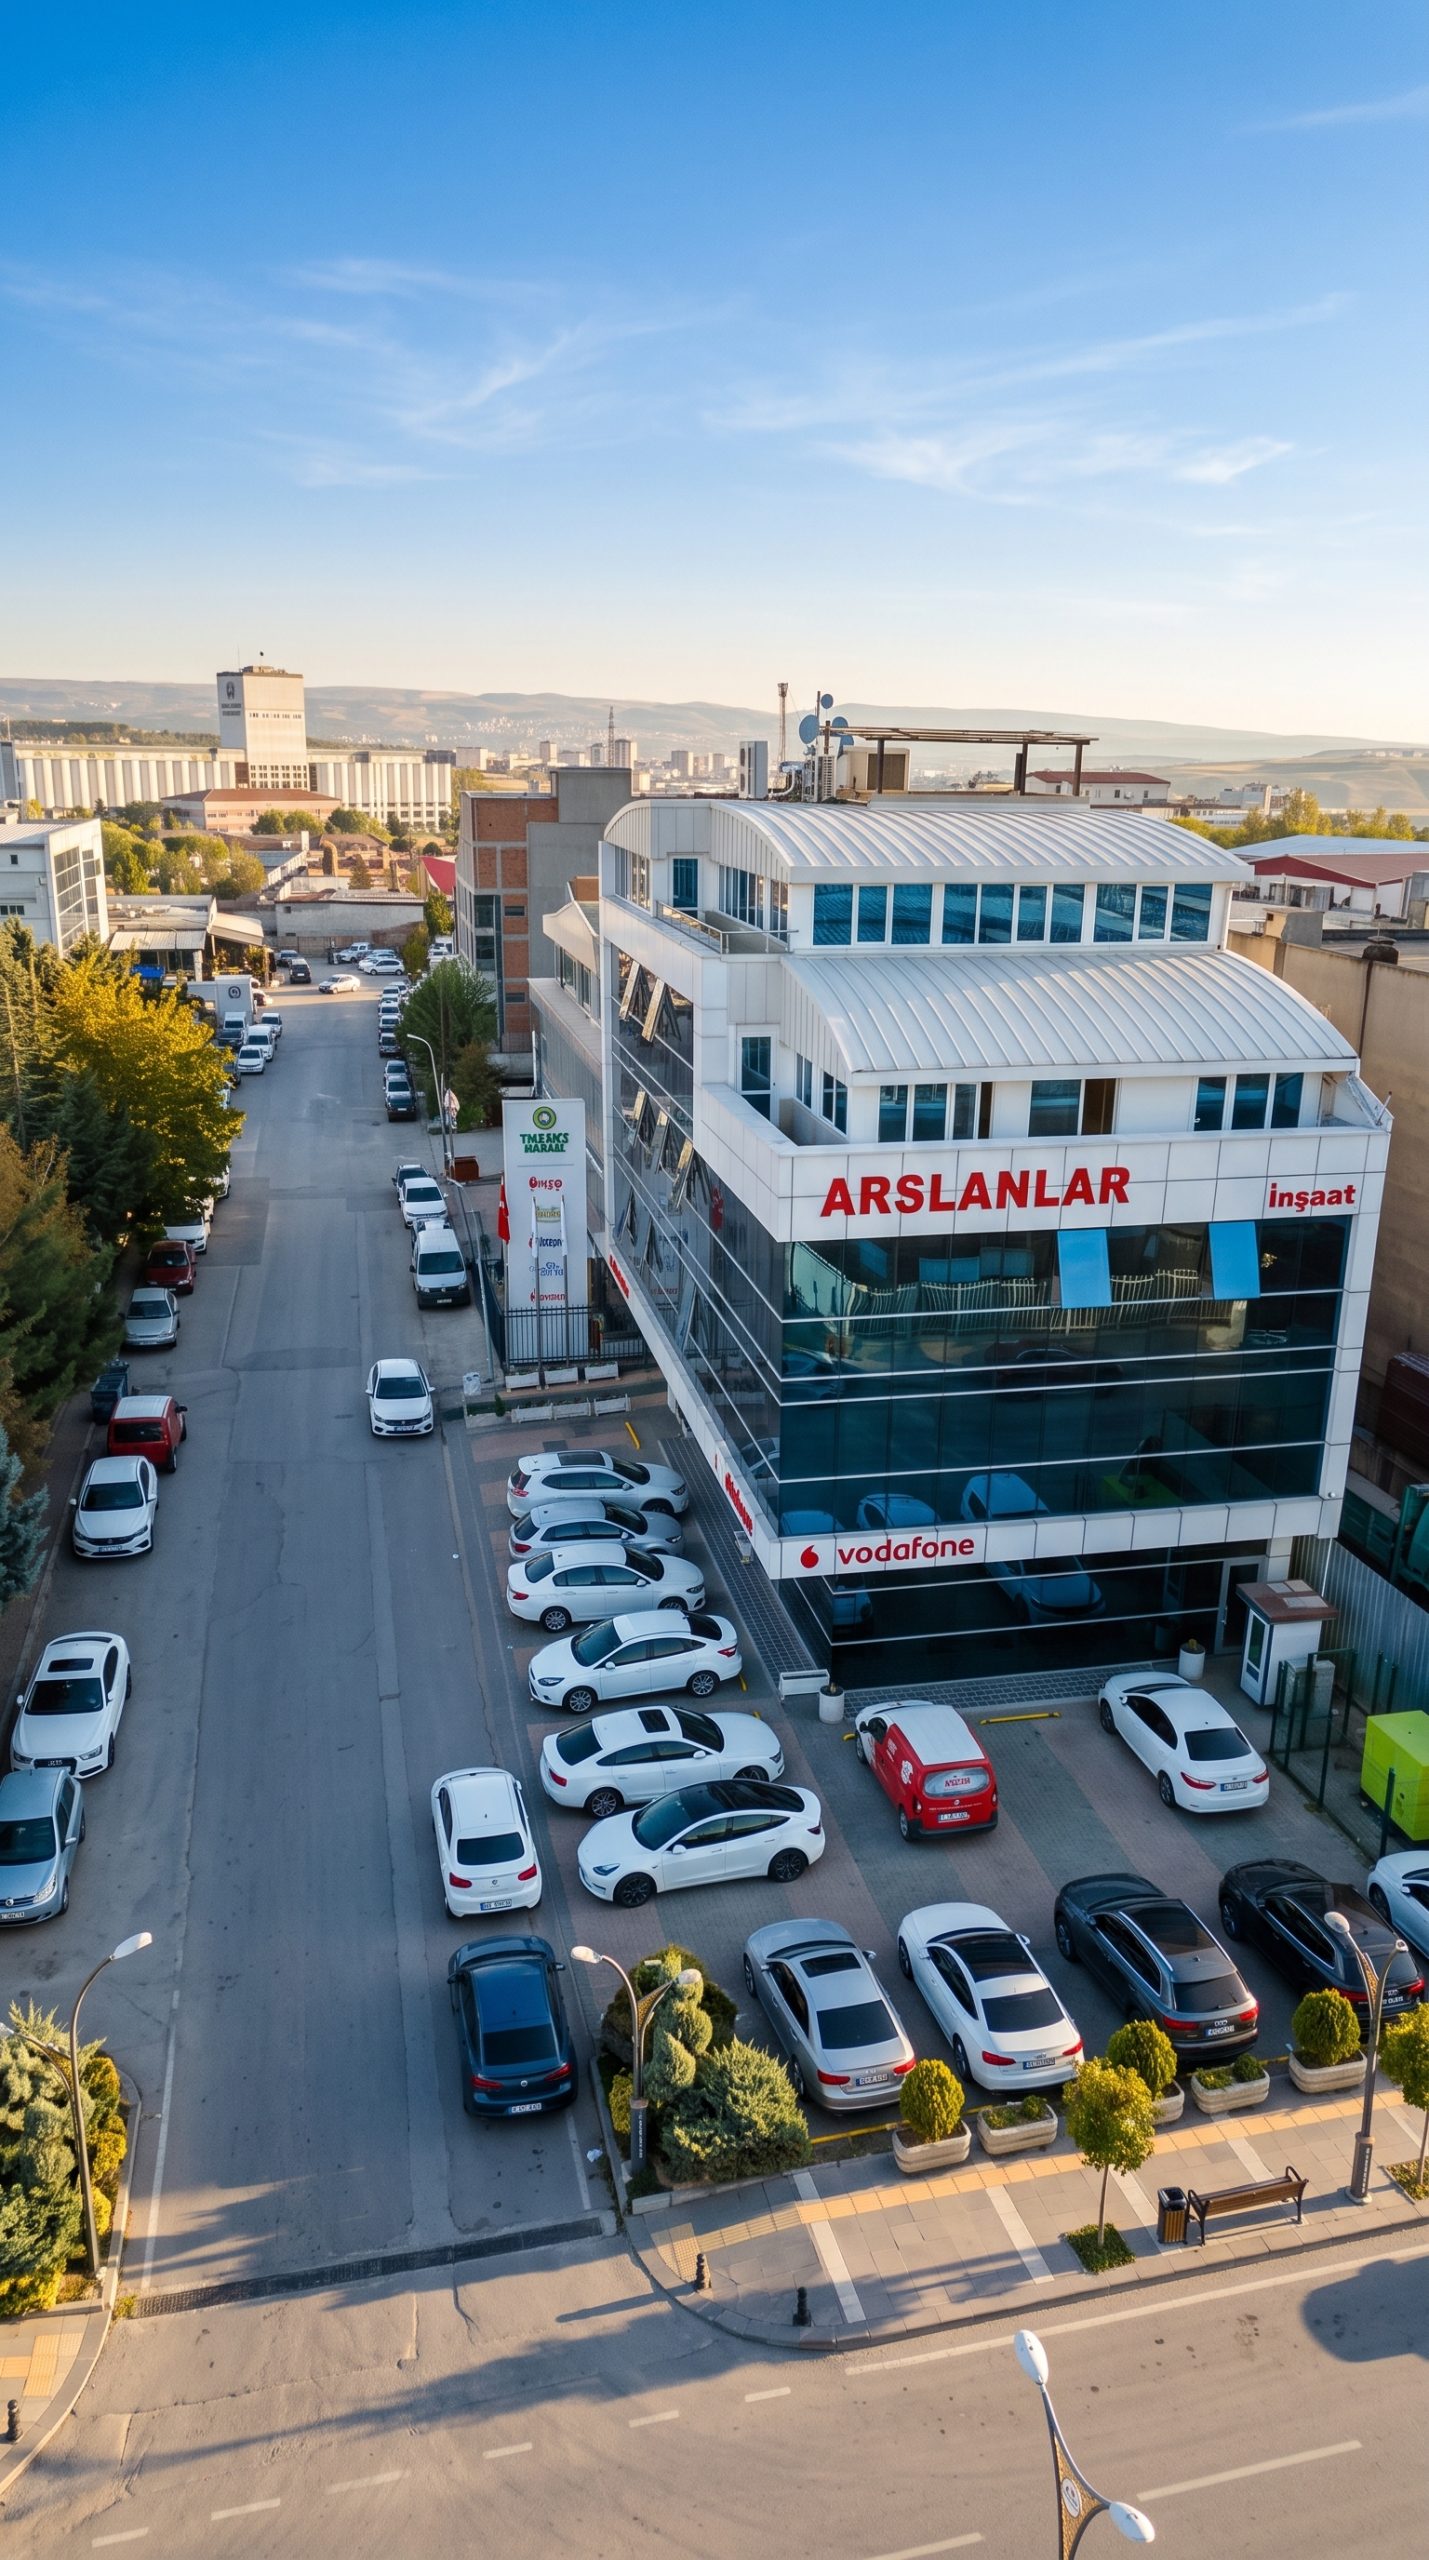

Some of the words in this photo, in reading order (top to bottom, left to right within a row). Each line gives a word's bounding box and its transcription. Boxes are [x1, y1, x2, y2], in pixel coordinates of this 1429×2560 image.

[820, 1167, 1130, 1217] ARSLANLAR
[1269, 1182, 1356, 1213] inşaat
[838, 1536, 975, 1565] vodafone
